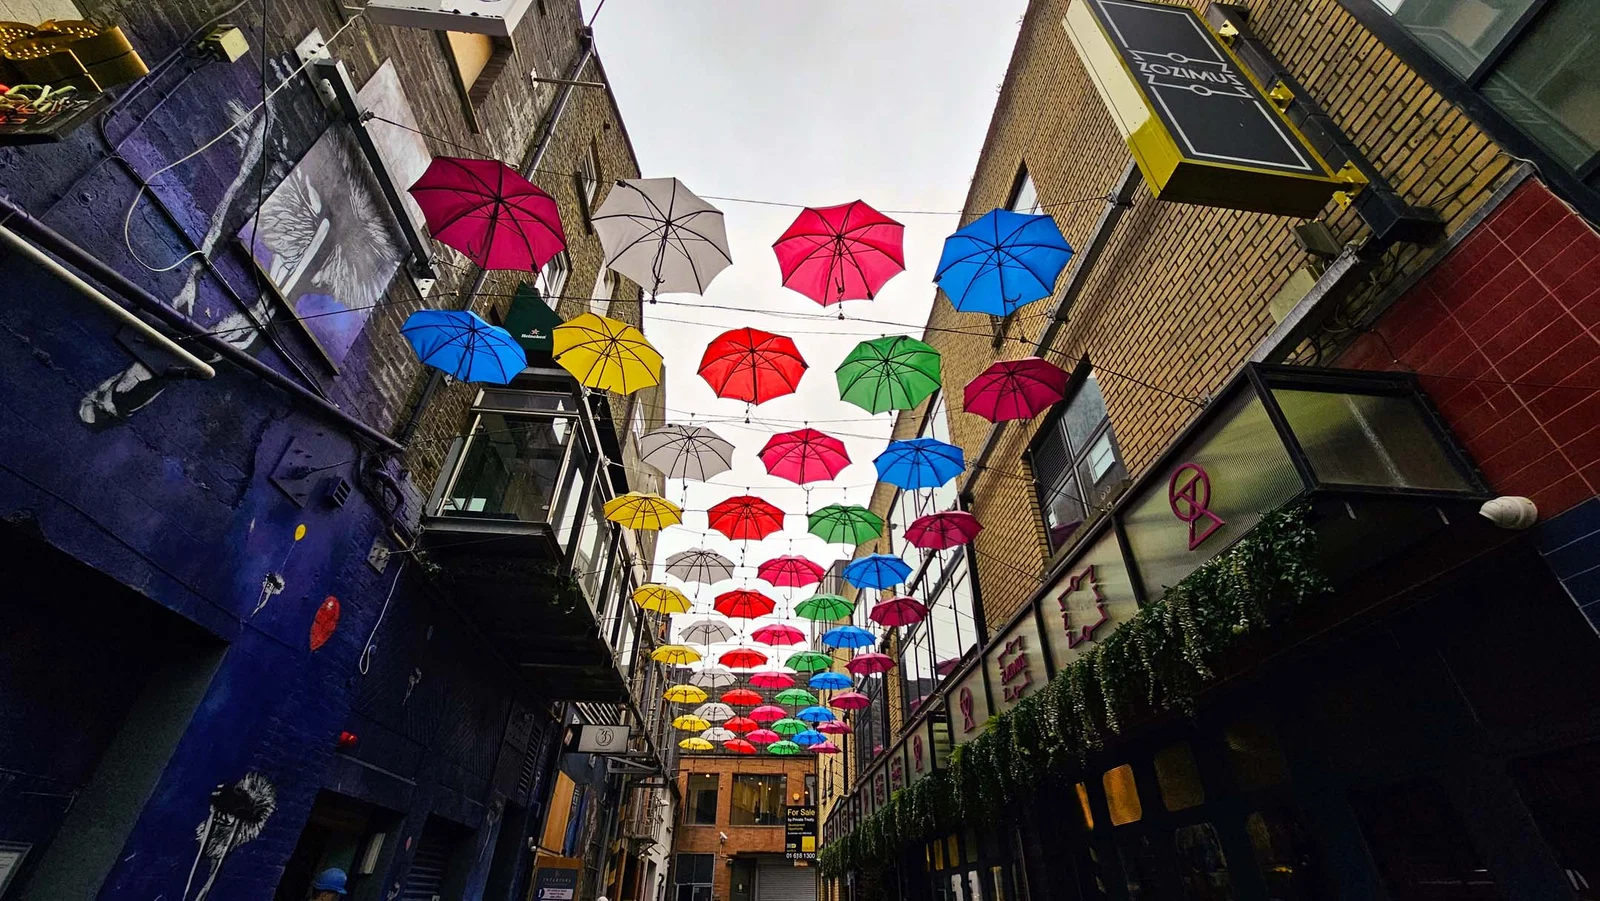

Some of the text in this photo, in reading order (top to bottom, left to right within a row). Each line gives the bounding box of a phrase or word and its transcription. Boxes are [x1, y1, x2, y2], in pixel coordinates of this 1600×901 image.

[1136, 61, 1244, 86] ZOZIMUS
[787, 808, 815, 816] For Sale
